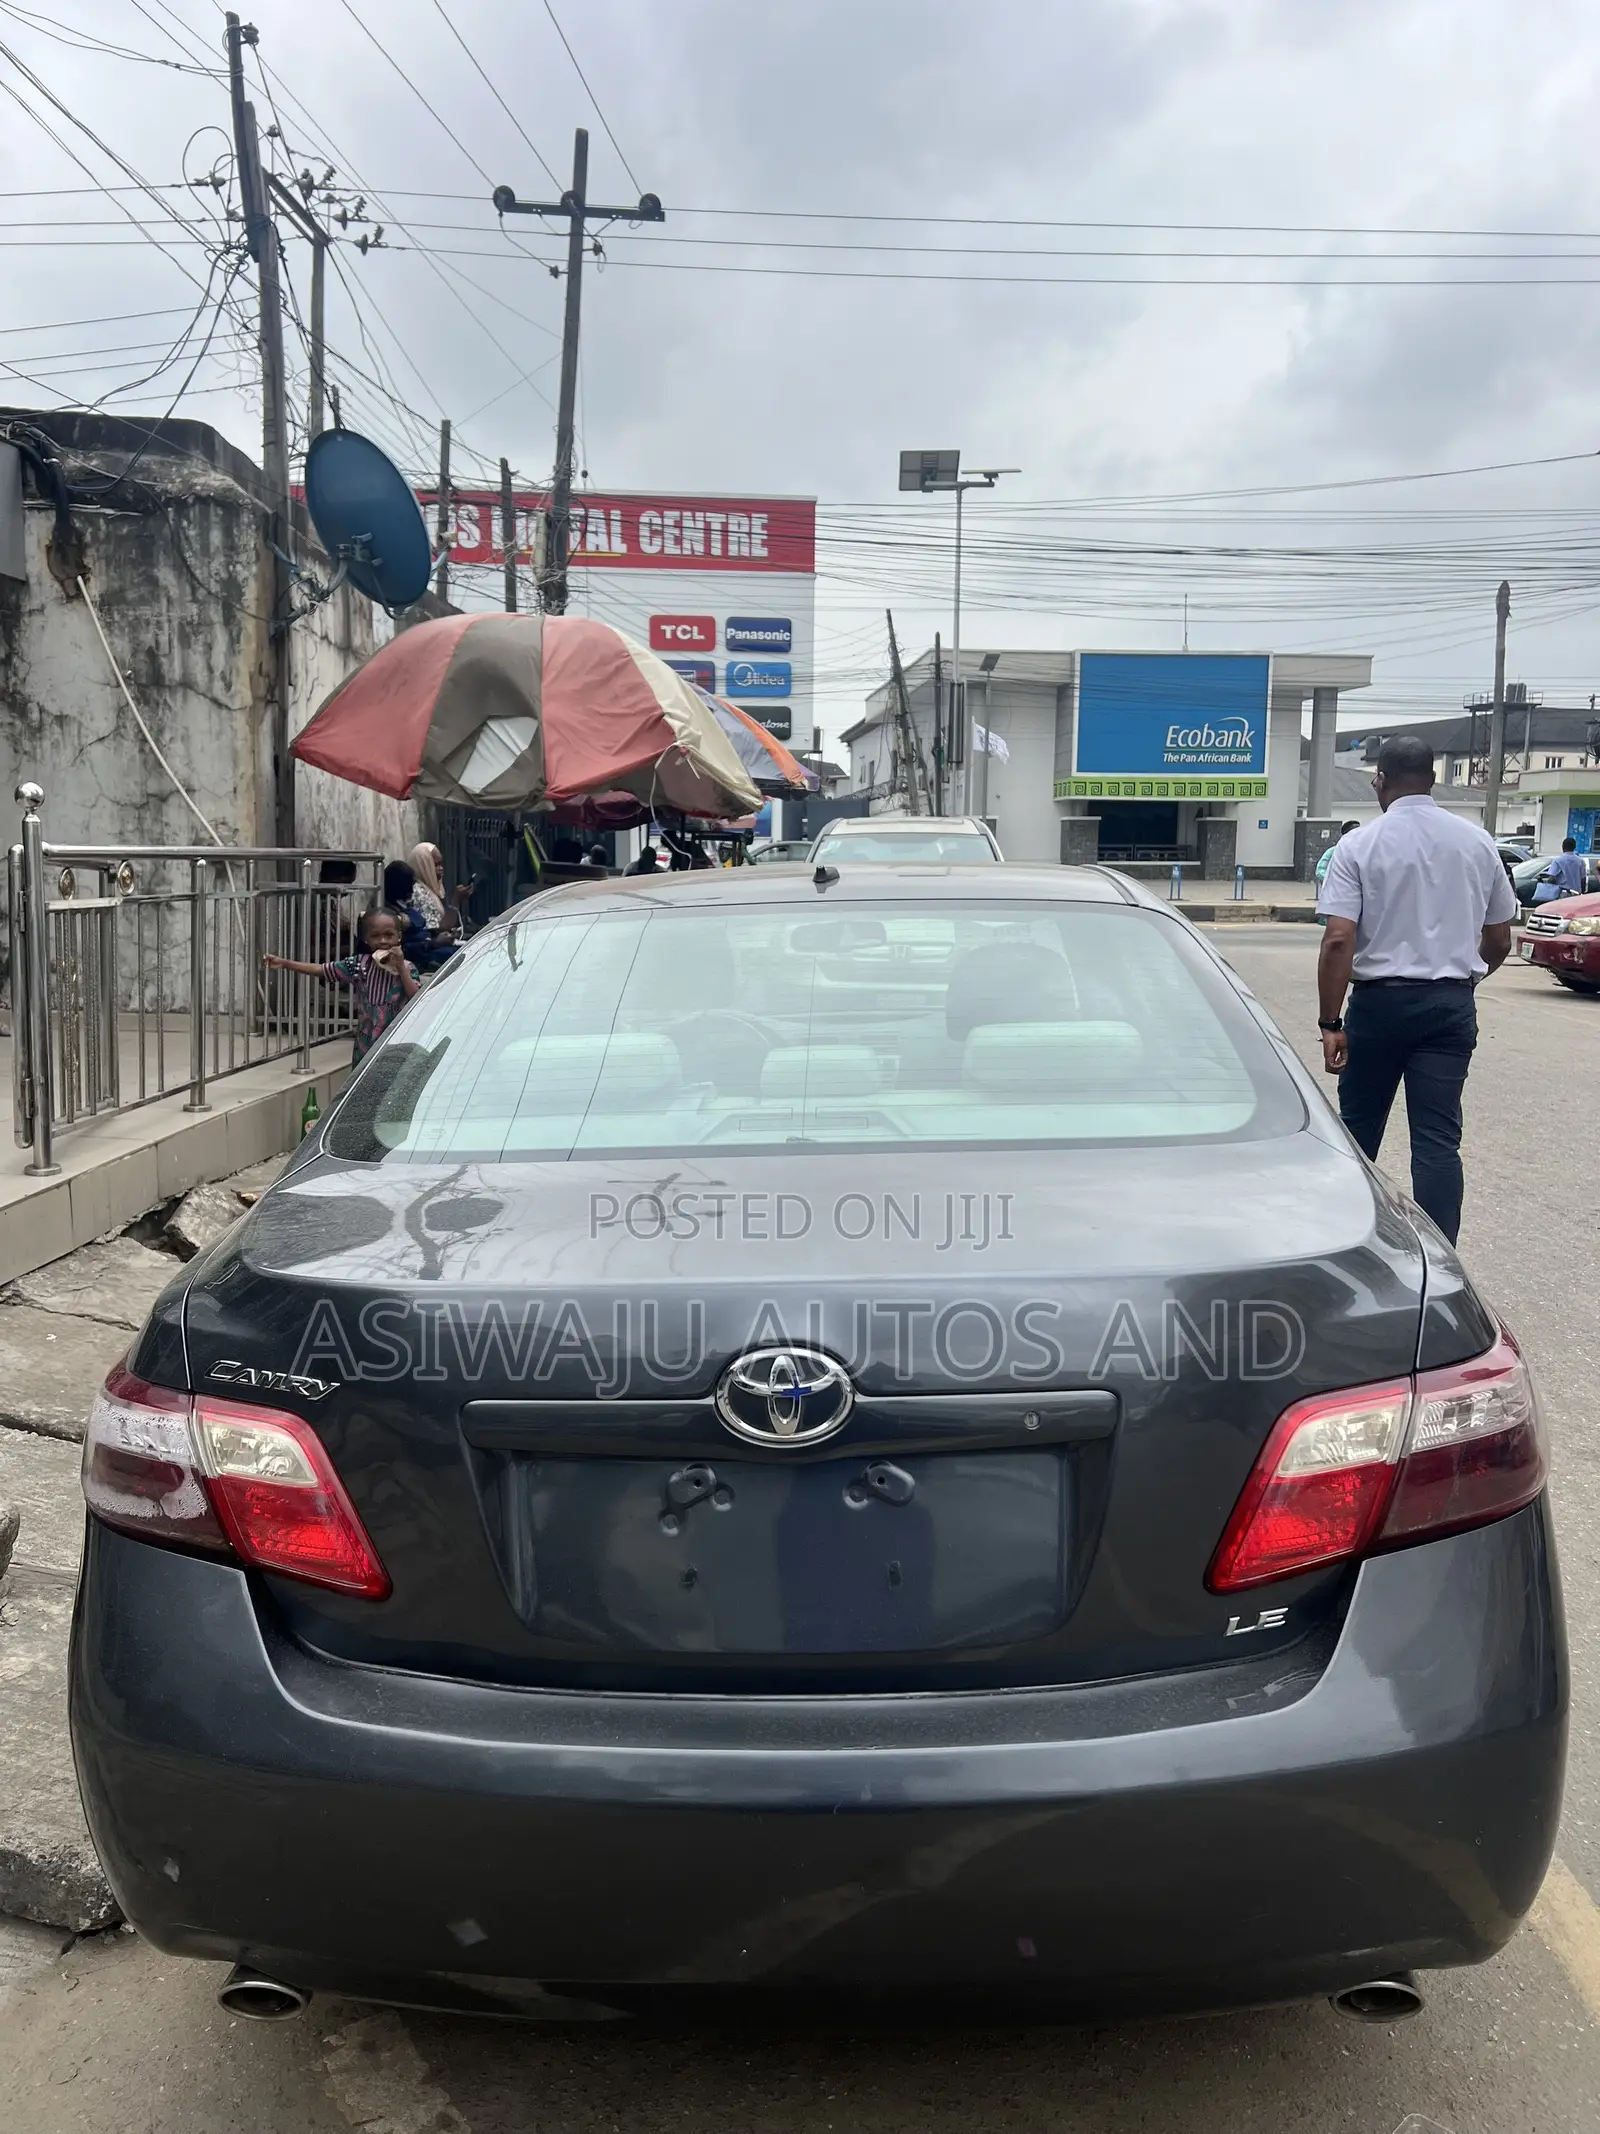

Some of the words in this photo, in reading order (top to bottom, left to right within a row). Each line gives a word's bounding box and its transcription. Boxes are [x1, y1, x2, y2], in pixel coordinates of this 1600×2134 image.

[639, 510, 768, 557] CENTRE
[660, 624, 706, 640] TCL
[726, 628, 791, 641] Panasonic
[738, 667, 785, 686] Midea
[759, 718, 790, 729] atone
[1165, 716, 1255, 748] Ecobank
[1163, 752, 1179, 763] The
[1180, 753, 1197, 763] Pan
[1197, 752, 1229, 763] African
[1230, 752, 1252, 763] Bank
[204, 1359, 341, 1401] CAMRY
[1223, 1607, 1289, 1637] LE
